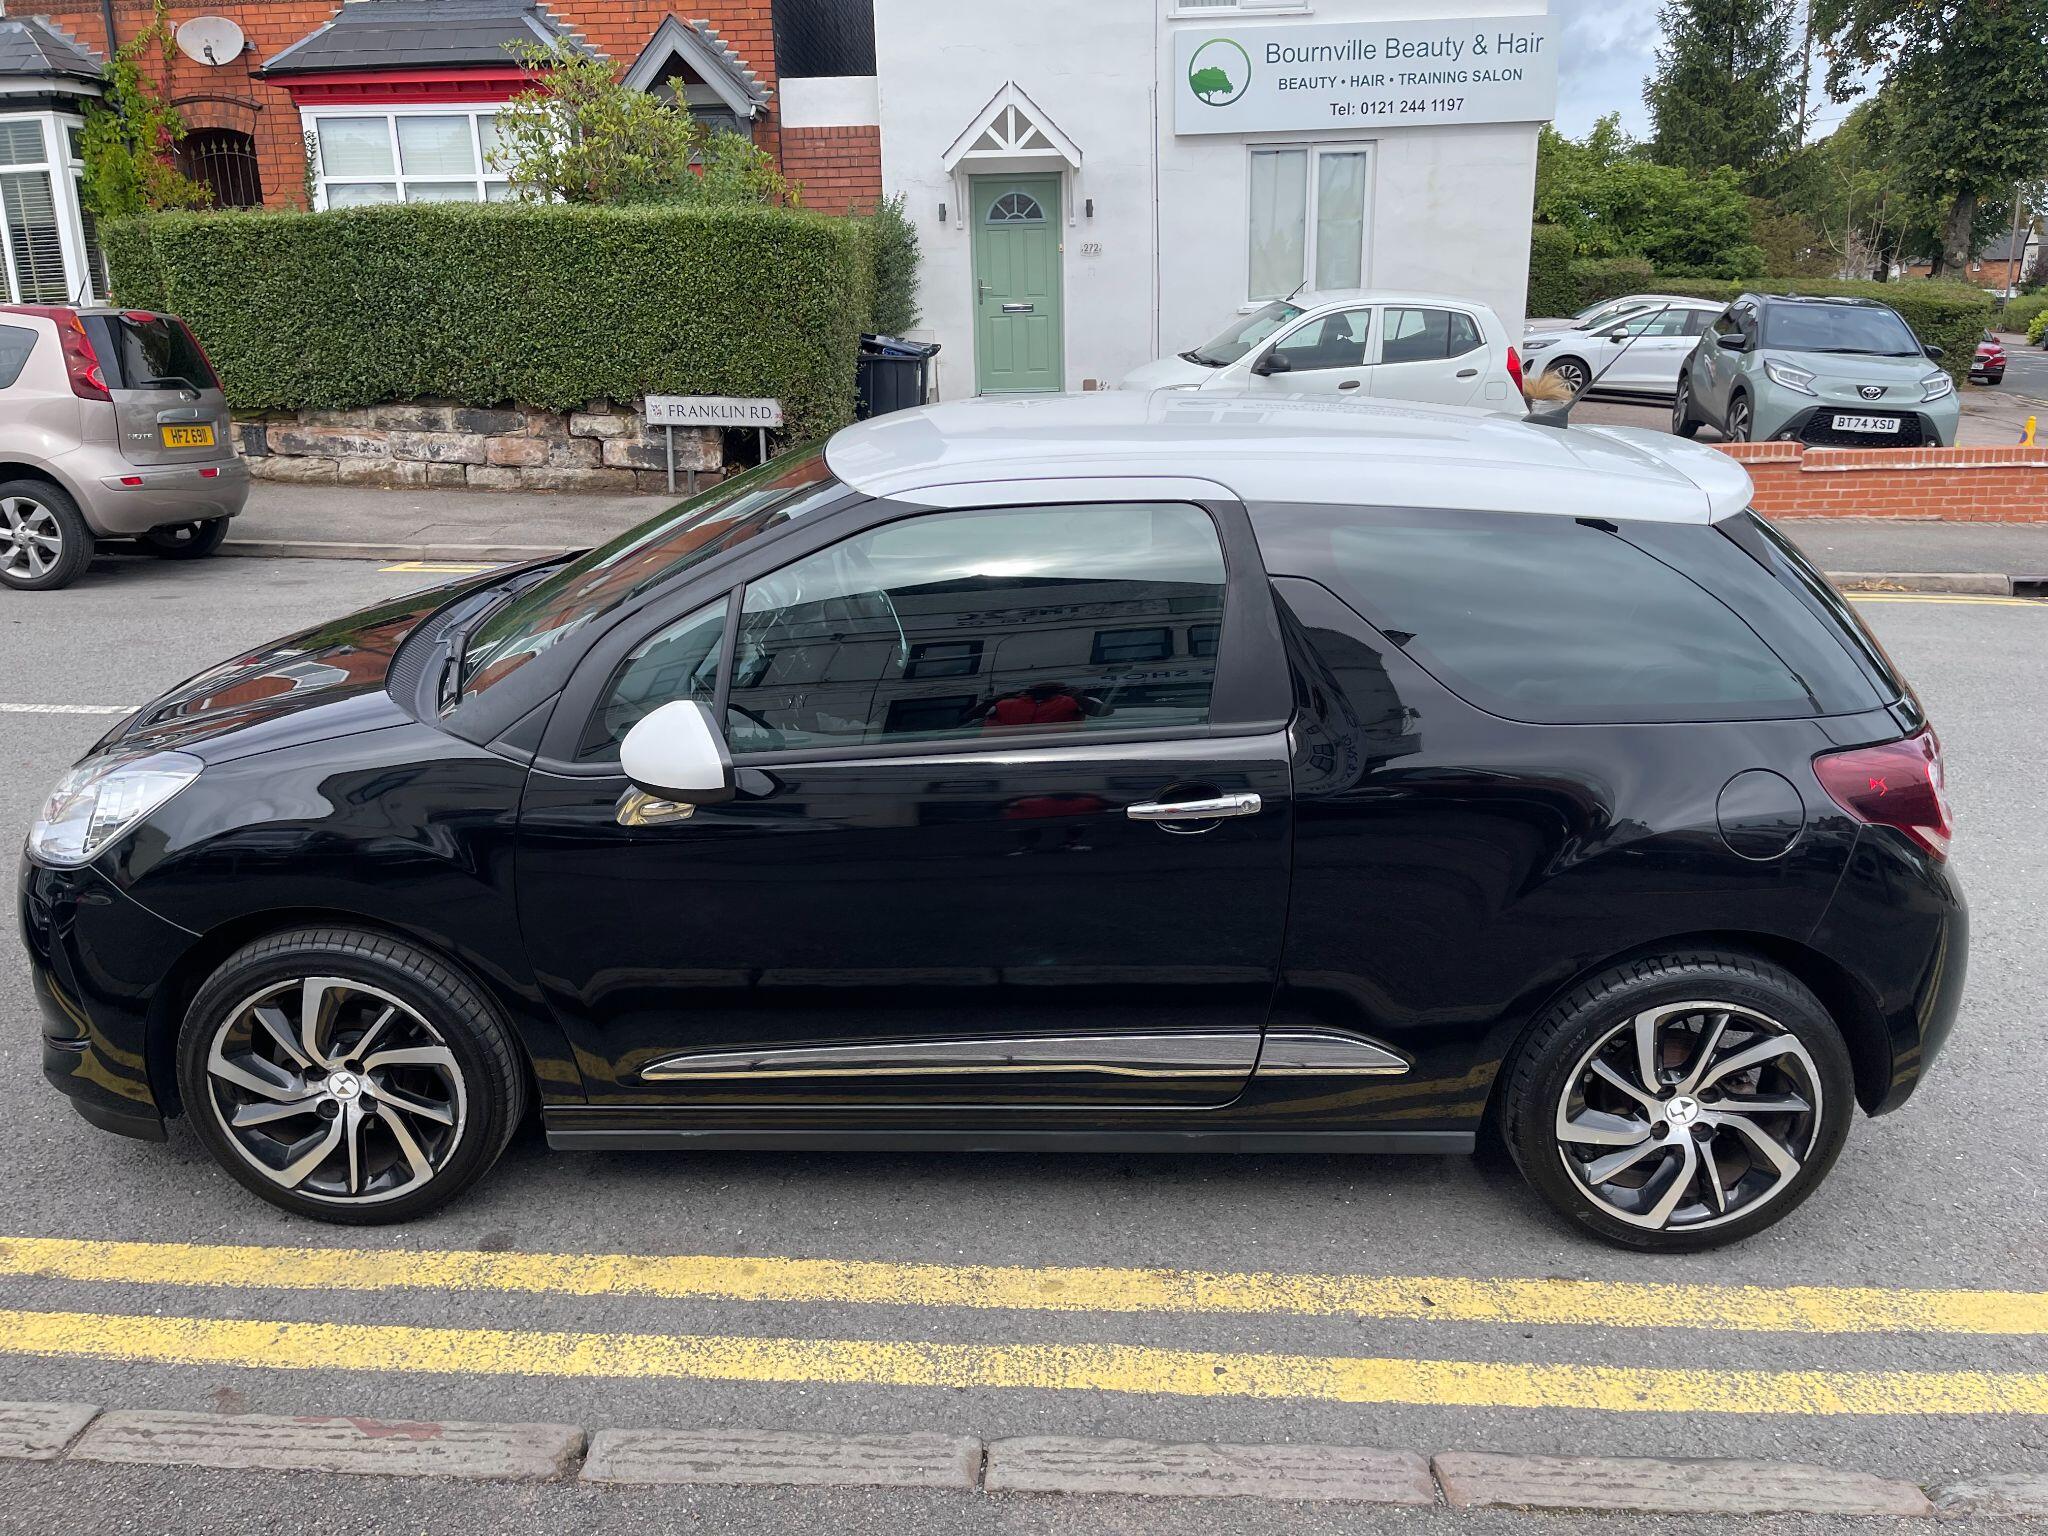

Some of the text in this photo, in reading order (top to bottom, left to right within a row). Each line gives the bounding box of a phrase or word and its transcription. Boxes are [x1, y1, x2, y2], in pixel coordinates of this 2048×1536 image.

[1266, 31, 1544, 64] Bournville Beauty & Hair
[1277, 68, 1524, 91] BEAUTY HAIR TRAINING SALON
[1329, 97, 1465, 117] Tel: 0121 244 1197
[1083, 243, 1099, 251] 272
[668, 404, 745, 418] FRANKLIN
[750, 406, 773, 419] RD.
[1838, 417, 1894, 430] BT74 XSD
[171, 429, 190, 444] HFZ
